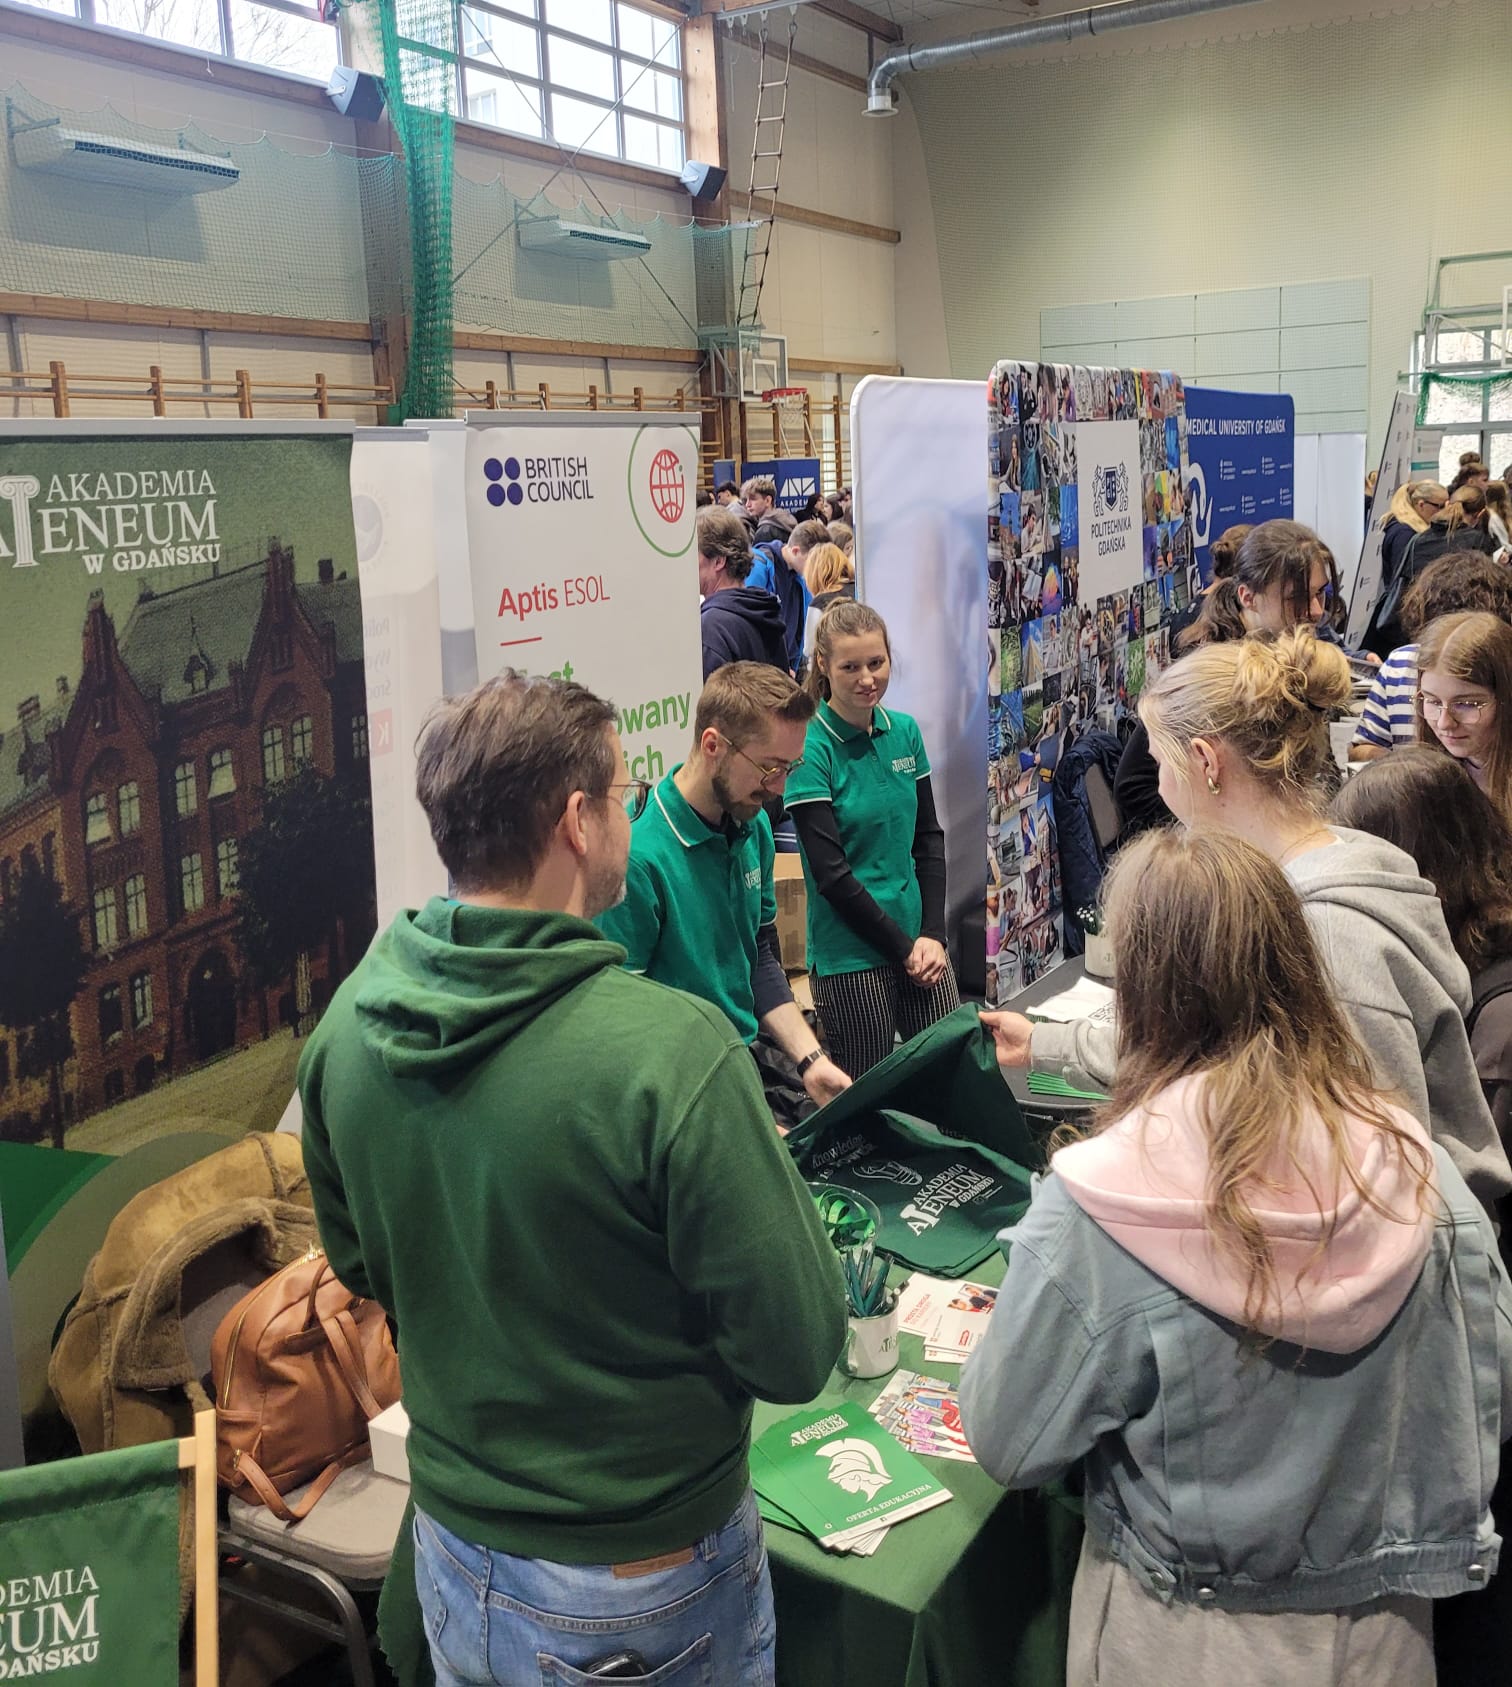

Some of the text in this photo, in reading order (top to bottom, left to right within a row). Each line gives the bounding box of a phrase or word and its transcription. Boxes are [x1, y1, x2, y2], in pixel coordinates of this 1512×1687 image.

[1186, 418, 1217, 436] MEDICAL
[1218, 418, 1255, 436] UNIVERSITY
[1255, 419, 1264, 435] OF
[524, 456, 588, 479] BRITISH
[46, 469, 217, 503] AKADEMIA
[527, 479, 595, 503] COUNCIL
[1091, 515, 1132, 540] POLITECHNIKA
[81, 542, 221, 575] W GDAŃSKU
[1097, 535, 1126, 557] GDAŃSKA
[497, 574, 611, 622] Aptis ESOL
[913, 1163, 968, 1206] AKADEMIA
[900, 1168, 987, 1237] ATENEUM
[845, 1483, 933, 1523] OFERTA EDUKACYJNA
